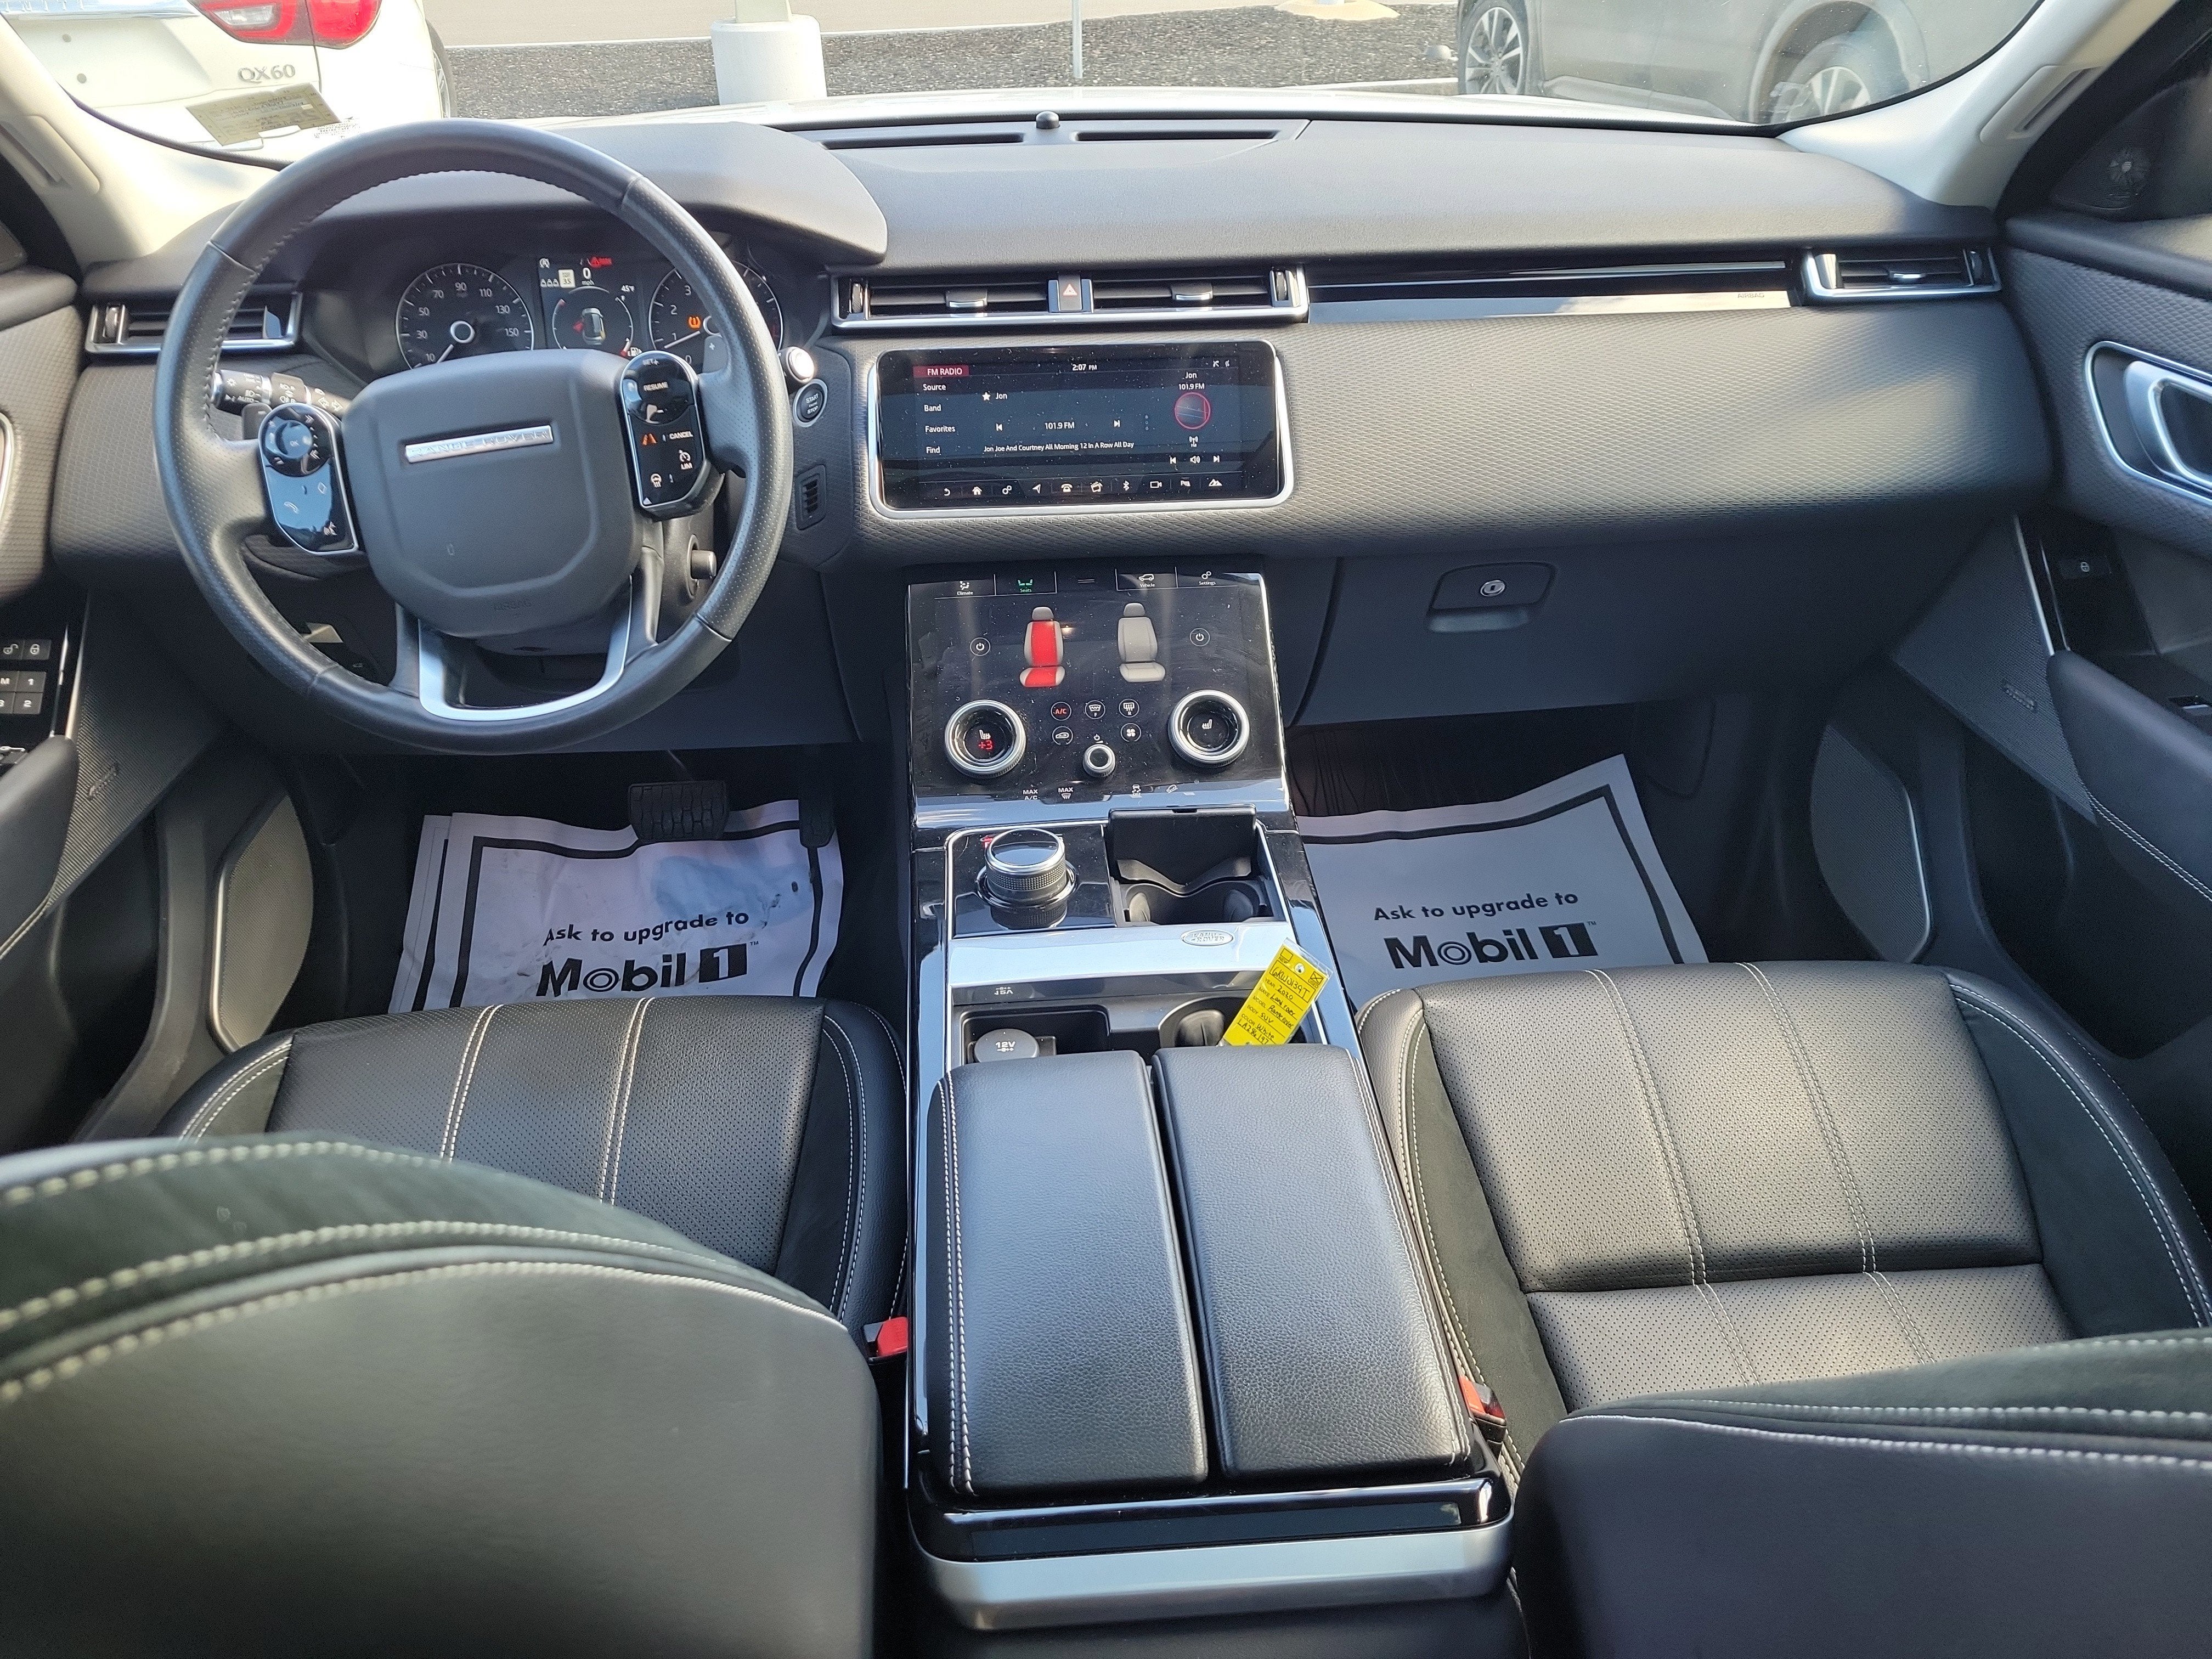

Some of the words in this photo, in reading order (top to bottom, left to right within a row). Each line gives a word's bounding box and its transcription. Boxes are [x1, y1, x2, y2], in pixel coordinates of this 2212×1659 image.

[238, 64, 296, 83] QX60
[583, 267, 591, 280] 0
[455, 282, 467, 291] 90
[685, 285, 691, 295] 3
[432, 289, 444, 298] 70
[479, 288, 492, 297] 110
[419, 307, 430, 316] 50
[495, 305, 510, 314] 130
[670, 305, 678, 315] 2
[416, 330, 427, 339] 30
[504, 328, 519, 337] 150
[426, 353, 436, 362] 10
[927, 368, 939, 376] FM
[940, 368, 963, 376] RADIO
[643, 382, 669, 392] RESUME
[806, 393, 819, 403] START
[807, 405, 819, 414] STOP
[924, 404, 942, 412] Band
[925, 425, 956, 433] Favorites
[1045, 421, 1063, 430] 101.9
[669, 431, 694, 439] CANCEL
[409, 440, 475, 457] RANGE
[482, 431, 548, 446] ROVER
[1018, 444, 1044, 453] Courtney
[24, 699, 32, 708] 2
[978, 740, 993, 751] +3
[1374, 905, 1416, 921] Ask
[1421, 905, 1444, 917] to
[1452, 893, 1549, 918] upgrade
[1555, 892, 1578, 905] to
[543, 923, 582, 946] Ask
[591, 928, 614, 942] to
[624, 913, 718, 945] upgrade
[726, 911, 749, 925] to
[1384, 928, 1539, 969] Mobil
[535, 952, 686, 997] Mobil
[1265, 978, 1276, 988] YEAR
[1308, 979, 1319, 989] USED
[1258, 986, 1270, 997] MAKE
[1277, 985, 1293, 1000] 2020
[1252, 995, 1266, 1008] MODEL
[1246, 1005, 1259, 1015] BODY
[1241, 1013, 1255, 1026] COLOR
[1260, 1012, 1273, 1024] SUV
[1257, 1023, 1275, 1040] White
